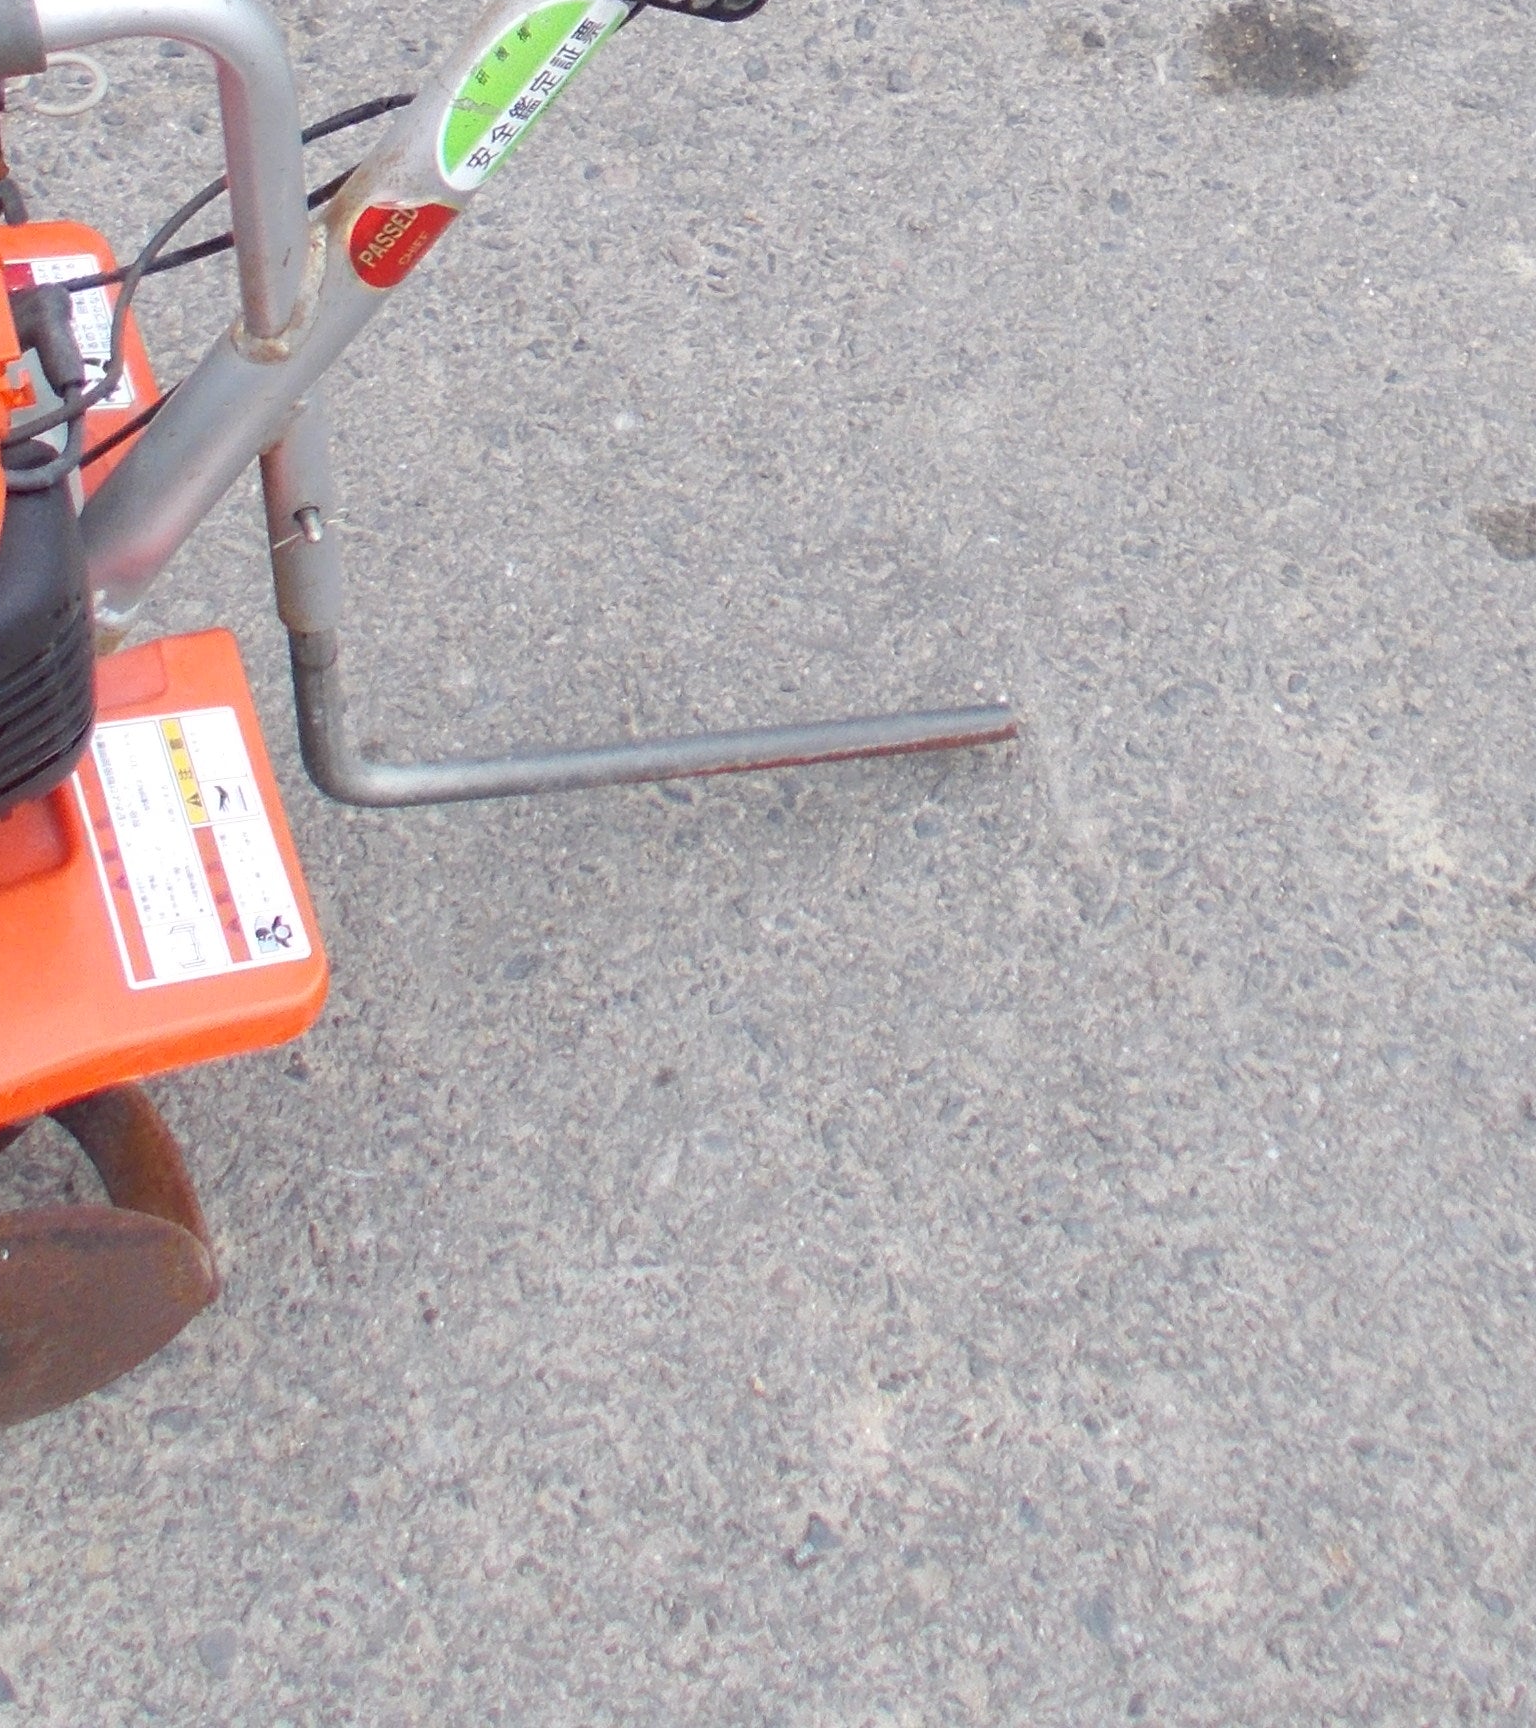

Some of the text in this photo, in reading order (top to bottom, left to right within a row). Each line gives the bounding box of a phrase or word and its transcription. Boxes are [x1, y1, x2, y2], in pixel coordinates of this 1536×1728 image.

[466, 17, 605, 171] 安全鑑定証票
